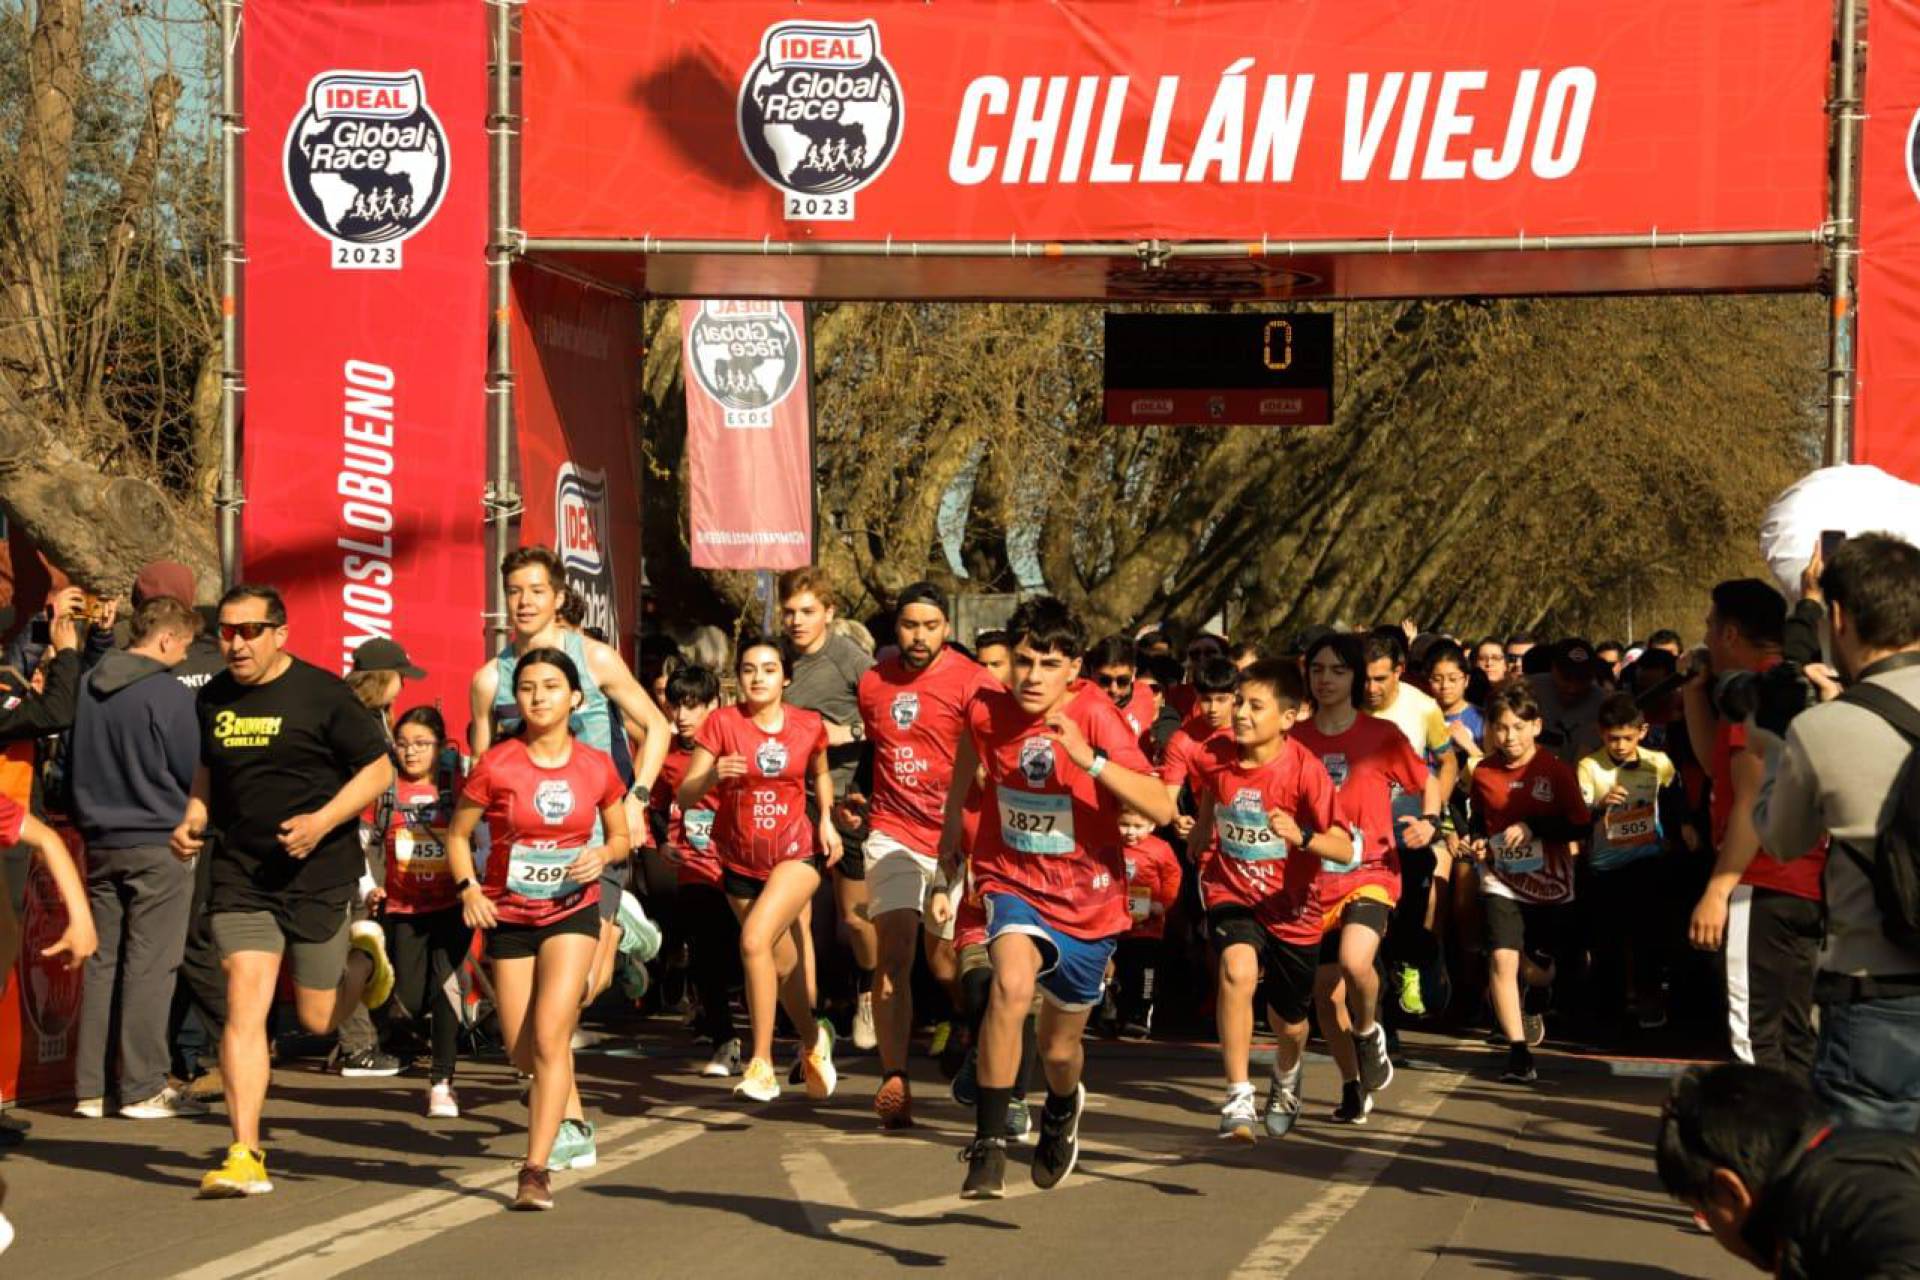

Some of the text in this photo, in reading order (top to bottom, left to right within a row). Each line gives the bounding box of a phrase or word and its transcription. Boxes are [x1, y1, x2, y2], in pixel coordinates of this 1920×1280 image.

[781, 39, 862, 59] IDEAL
[787, 72, 880, 99] Global
[326, 89, 408, 108] IDEAL
[764, 95, 839, 120] Race
[948, 57, 1597, 185] CHILLÁN VIEJO
[333, 122, 425, 148] Global
[311, 144, 387, 169] Race
[791, 199, 848, 215] 2023
[338, 249, 395, 263] 2023
[1264, 321, 1292, 370] 0
[337, 359, 395, 677] MOSLOBUENO
[893, 746, 913, 760] TO
[895, 760, 928, 774] RON
[896, 775, 918, 787] TO
[753, 791, 776, 803] TO
[754, 804, 788, 816] RON
[753, 818, 776, 829] TO
[1008, 809, 1056, 833] 2827
[1621, 821, 1648, 835] 505
[1225, 823, 1271, 844] 2736
